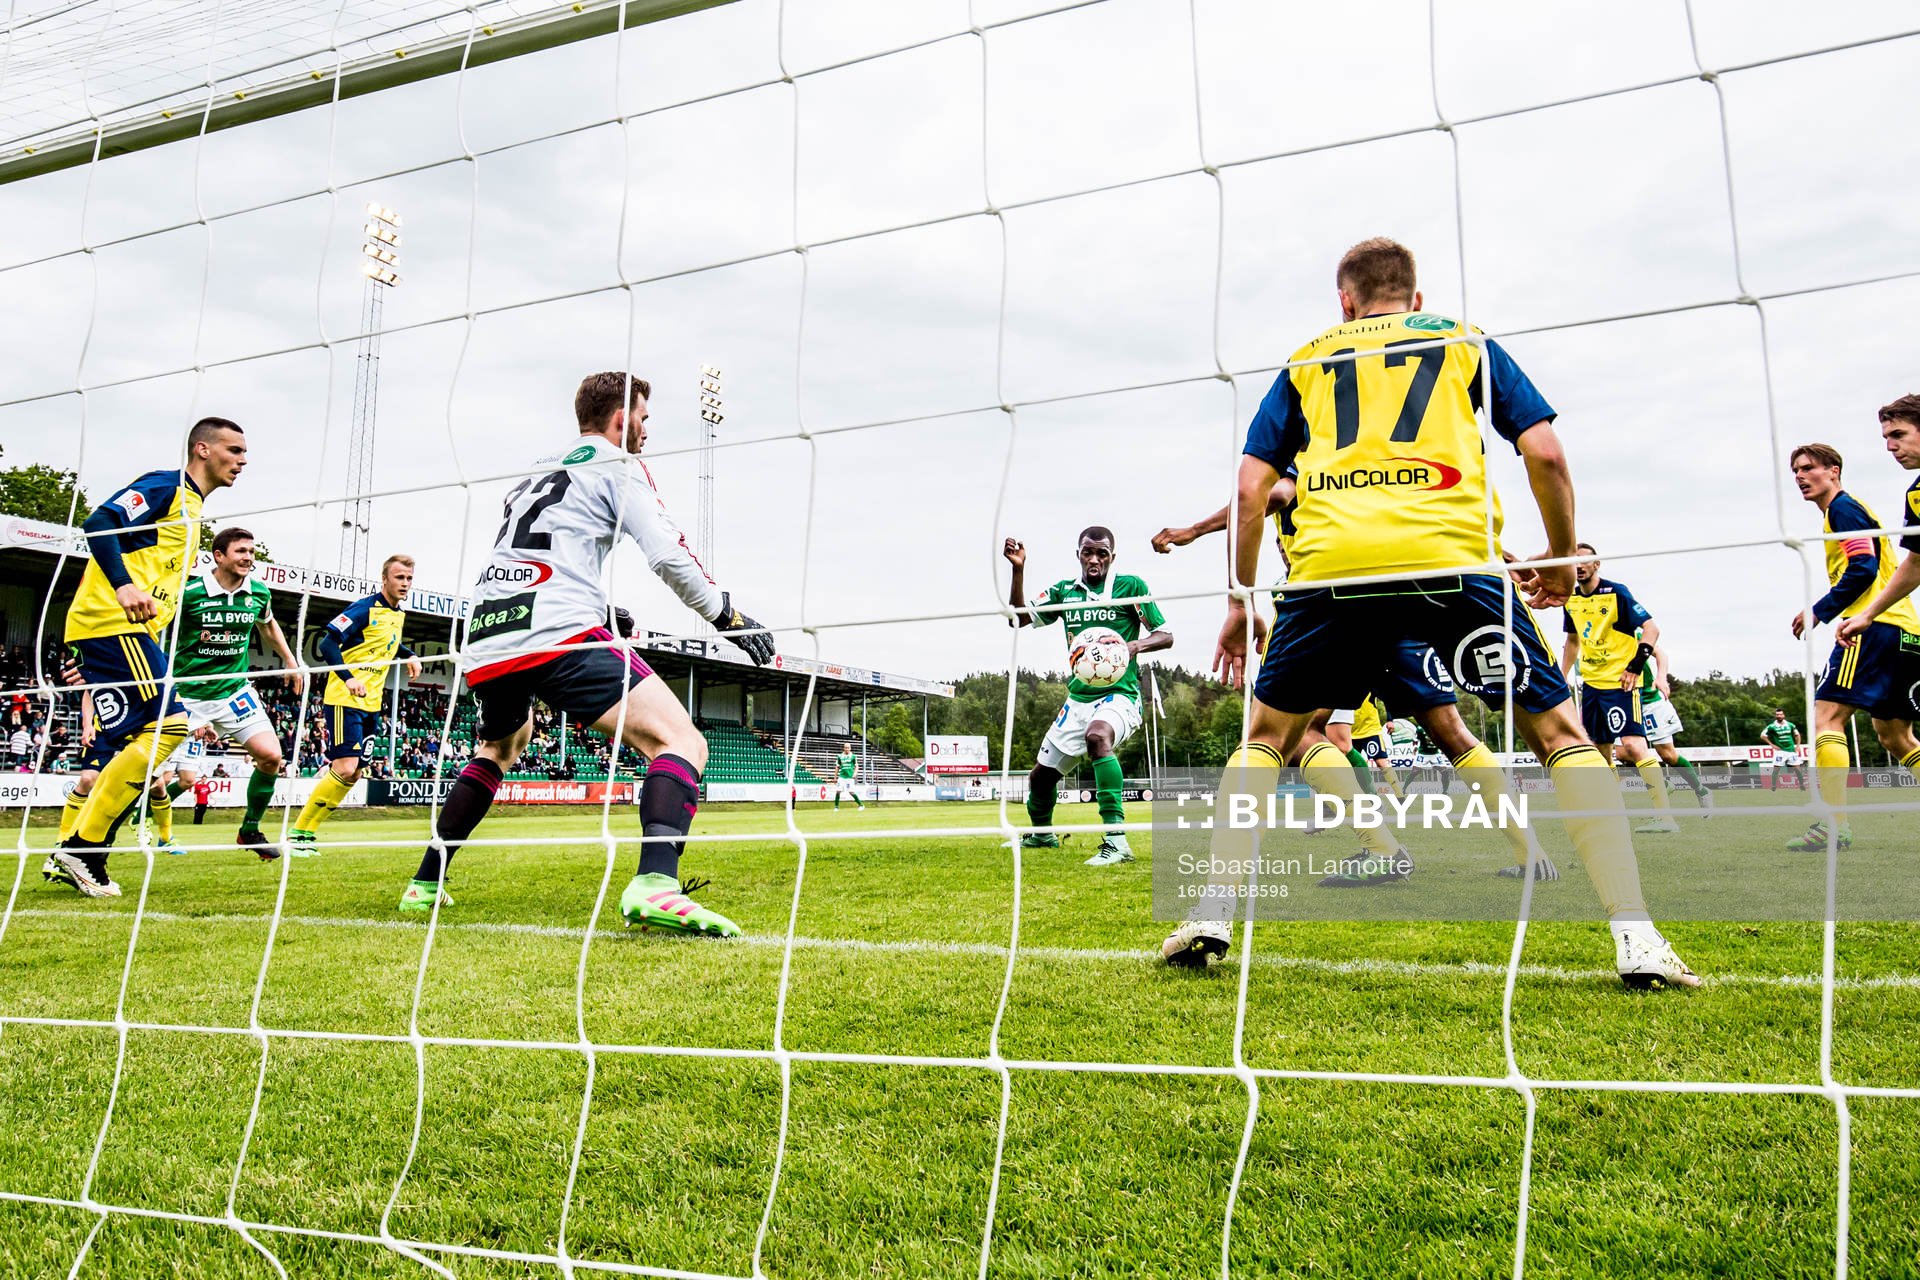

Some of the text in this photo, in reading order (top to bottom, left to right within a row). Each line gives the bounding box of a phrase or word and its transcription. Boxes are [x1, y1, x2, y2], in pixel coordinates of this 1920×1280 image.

[1322, 338, 1446, 451] 17
[262, 566, 287, 584] JTB
[324, 574, 355, 593] BYGG
[202, 612, 255, 624] H.A BYGG
[1065, 609, 1117, 622] H.A BYGG
[388, 781, 456, 797] PONDUS
[511, 784, 526, 801] för
[526, 784, 555, 800] svensk
[555, 784, 587, 800] fotboll!
